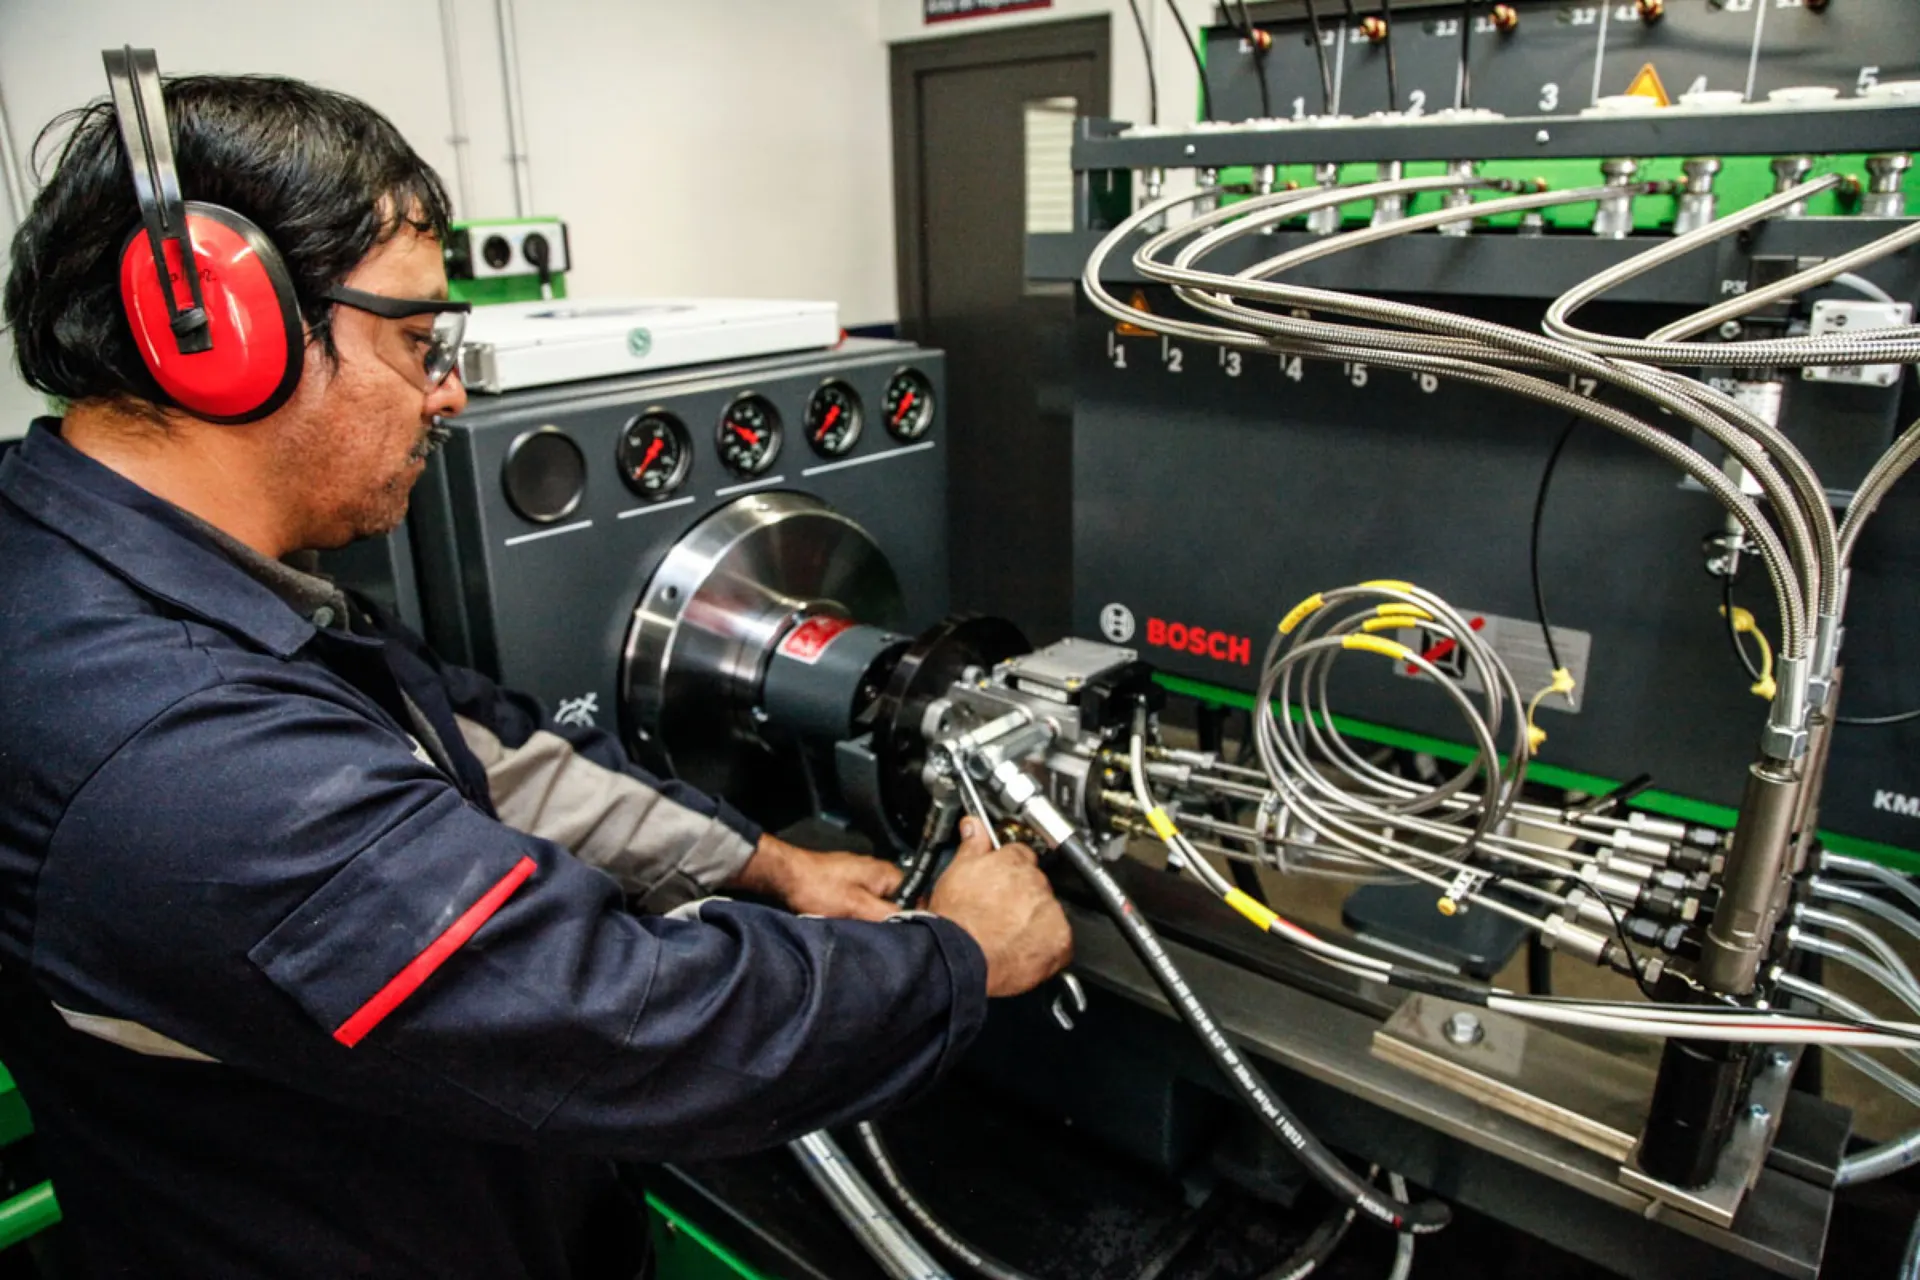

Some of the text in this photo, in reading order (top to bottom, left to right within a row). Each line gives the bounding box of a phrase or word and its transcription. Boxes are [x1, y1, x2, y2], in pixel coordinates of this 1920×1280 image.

[1855, 66, 1880, 97] 5
[1292, 96, 1306, 118] 1
[1408, 89, 1427, 116] 2
[1538, 82, 1560, 112] 3
[1113, 344, 1128, 368] 1
[1167, 347, 1184, 372] 2
[1225, 352, 1242, 377] 3
[1285, 356, 1304, 382] 4
[1351, 363, 1369, 388] 5
[1419, 373, 1439, 394] 6
[1578, 378, 1598, 398] 7
[1146, 617, 1251, 666] BOSCH
[1872, 788, 1920, 818] KM
